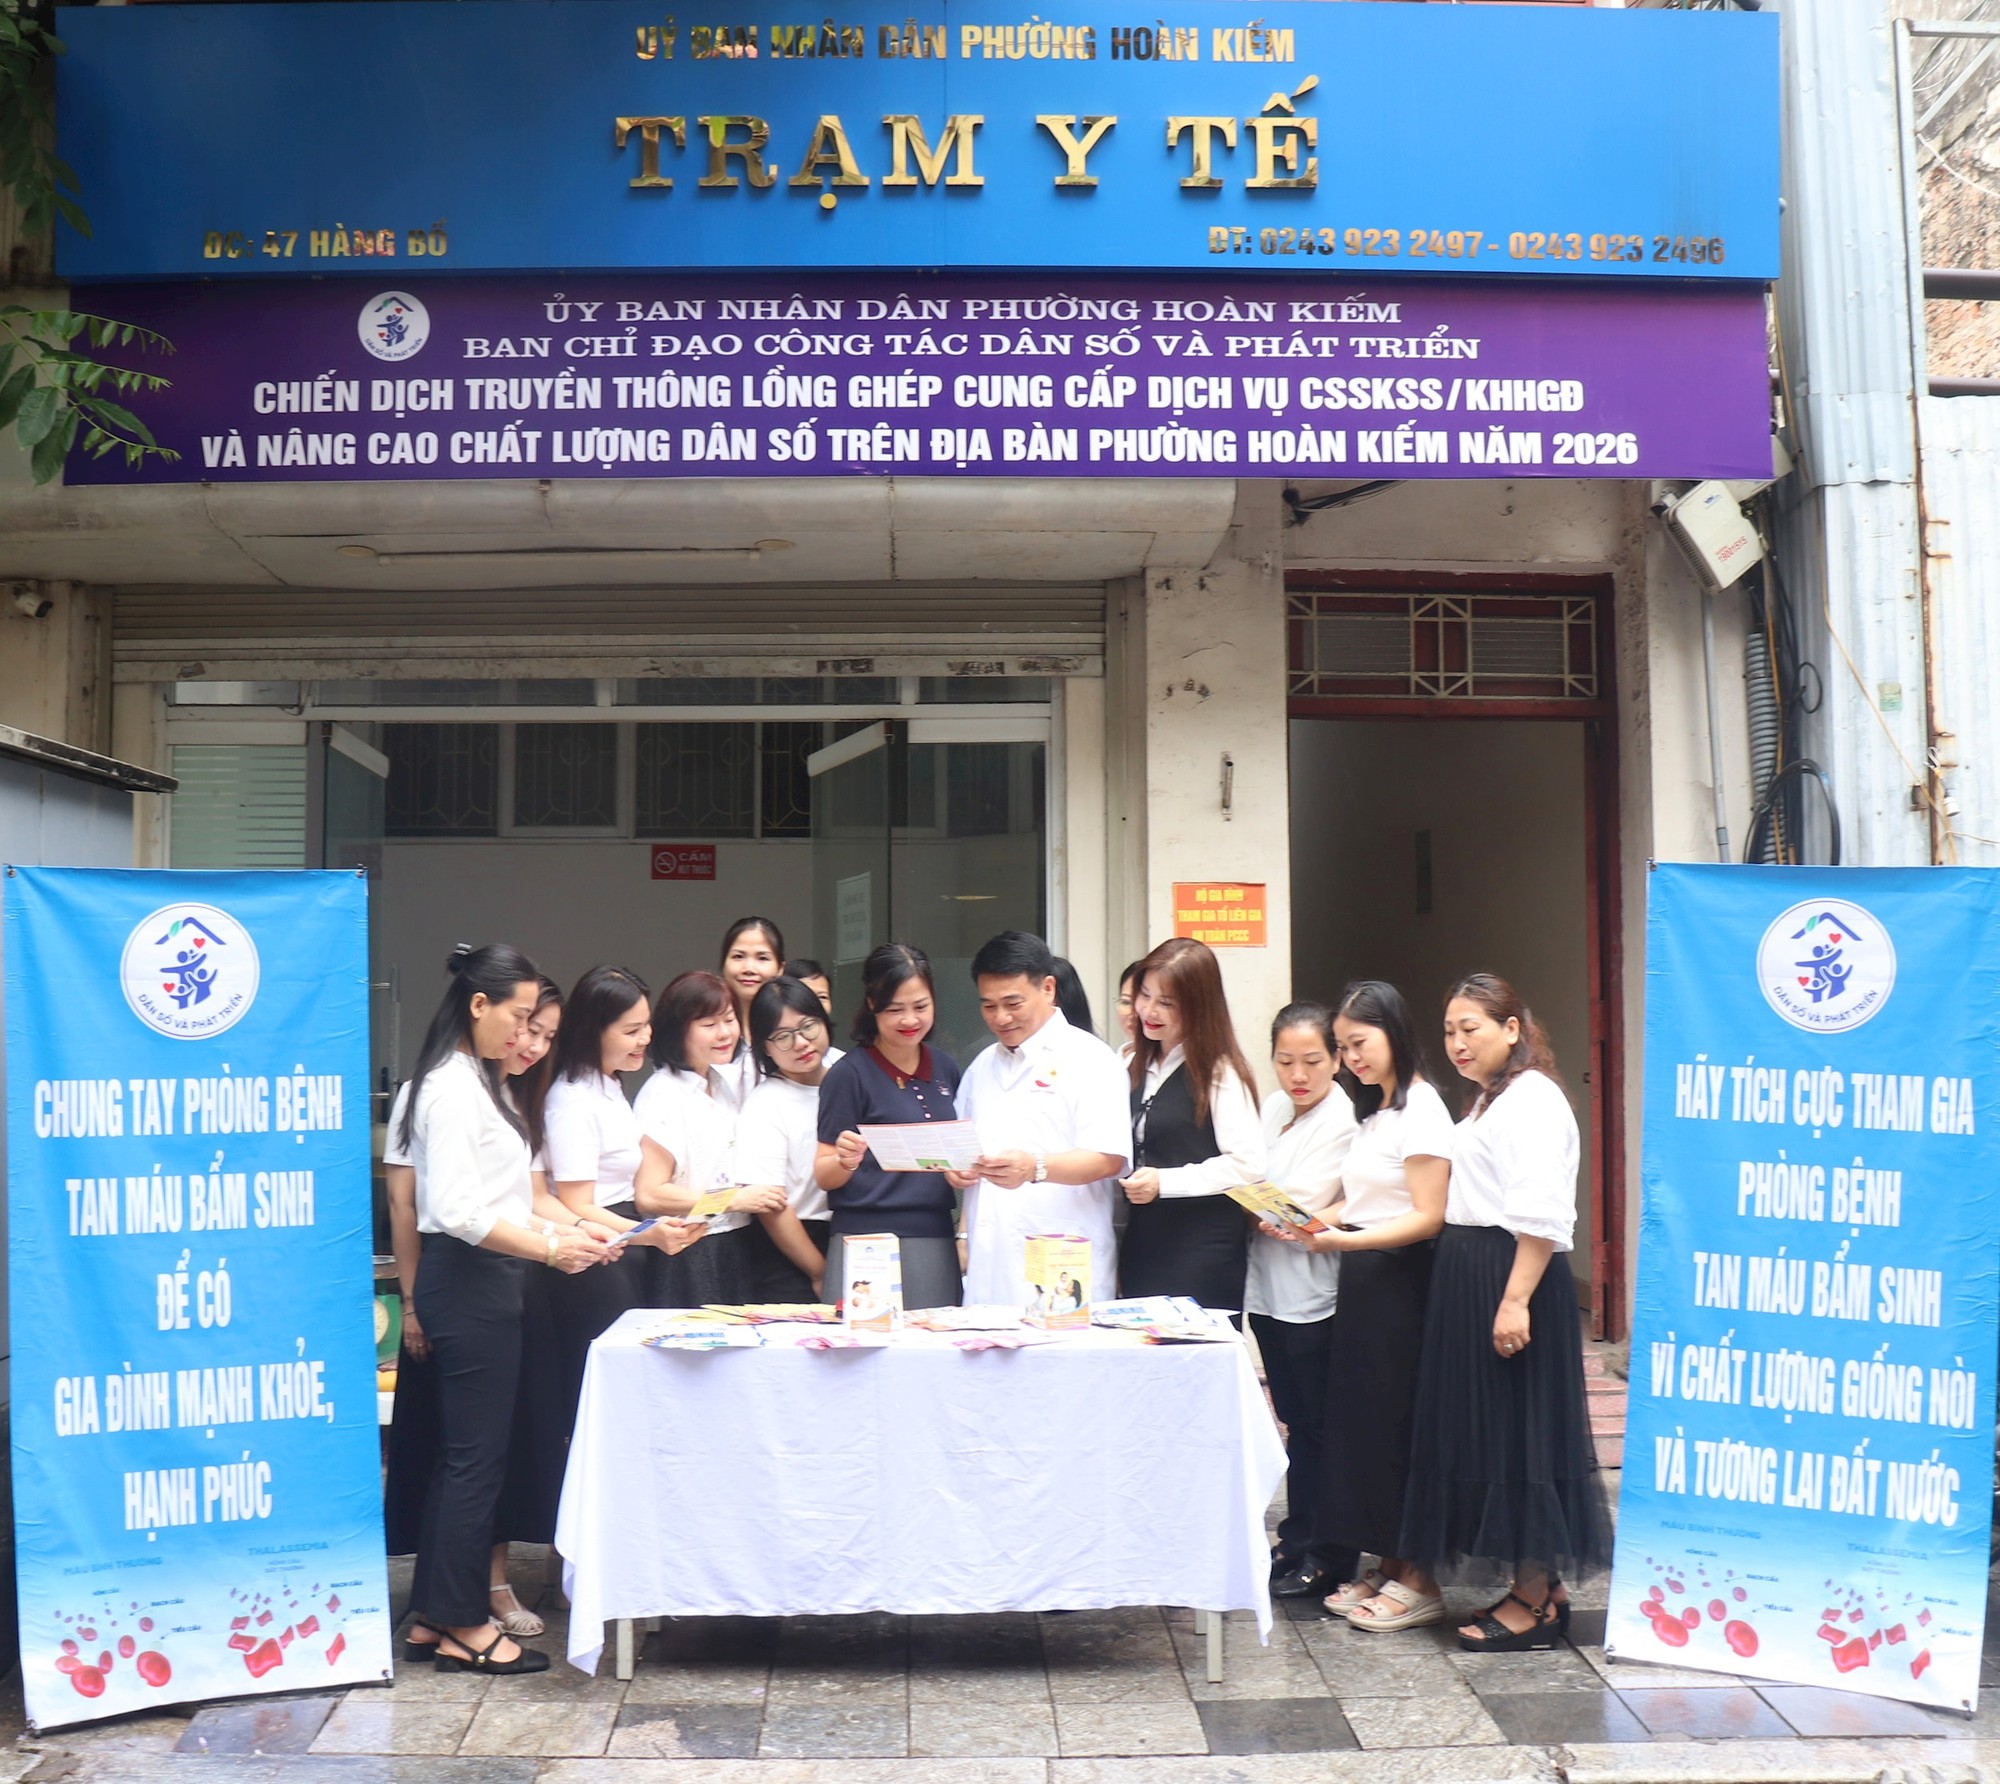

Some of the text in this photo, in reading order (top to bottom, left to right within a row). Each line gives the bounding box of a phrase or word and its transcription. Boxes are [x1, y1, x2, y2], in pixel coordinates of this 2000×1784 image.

[690, 24, 758, 60] BAN
[770, 17, 864, 59] NHÂN
[878, 17, 947, 59] DÂN
[960, 15, 1097, 60] PHƯỜNG
[1111, 19, 1199, 61] HOÀN
[1212, 18, 1296, 63] KIẾM
[614, 74, 1320, 210] TRẠM Y TẾ
[262, 231, 299, 258] 47
[309, 222, 396, 257] HÀNG
[1259, 227, 1334, 255] 0243
[1343, 228, 1400, 258] 923
[1408, 231, 1483, 258] 2497
[1508, 231, 1582, 260] 0243
[1589, 234, 1644, 263] 923
[1652, 236, 1726, 265] 2496
[463, 324, 1481, 361] BAN CHỈ ĐẠO CÔNG TÁC DÂN SỐ VÀ PHÁT TRIỂN
[543, 292, 1402, 323] ỦY BAN NHÂN DÂN PHƯỜNG HOÀN KIẾM
[253, 364, 1584, 419] CHIẾN DỊCH TRUYỀN THÔNG LỒNG GHÉP CUNG CẤP DỊCH VỤ CSSKSS/KHHGĐ
[201, 417, 1639, 470] VÀ NÂNG CAO CHẤT LƯỢNG DÂN SỐ TRÊN ĐỊA BÀN PHƯỜNG HOÀN KIẾM NĂM 2026
[137, 994, 158, 1015] DÂN
[156, 1012, 174, 1025] SỐ
[175, 1018, 188, 1029] VÀ
[191, 1015, 218, 1030] PHÁT
[1773, 986, 1792, 1007] DÂN
[1791, 1004, 1807, 1017] SỐ
[1808, 1012, 1821, 1022] VÀ
[1823, 1010, 1851, 1022] PHÁT
[34, 1063, 343, 1144] CHUNG TAY PHÒNG BỆNH
[1675, 1053, 1975, 1139] HÃY TÍCH CỰC THAM GIA
[65, 1149, 315, 1236] TAN MÁU BẨM SINH
[1737, 1149, 1902, 1238] PHÒNG BỆNH
[156, 1248, 232, 1331] ĐỂ CÓ
[1693, 1239, 1942, 1328] TAN MÁU BẨM SINH
[54, 1336, 335, 1439] GIA ĐÌNH MẠNH KHỎE,
[1651, 1328, 1976, 1430] VÌ CHẤT LƯỢNG GIỐNG NÒI
[124, 1450, 273, 1542] HẠNH PHÚC
[1655, 1425, 1960, 1528] VÀ TƯƠNG LAI ĐẤT NƯỚC
